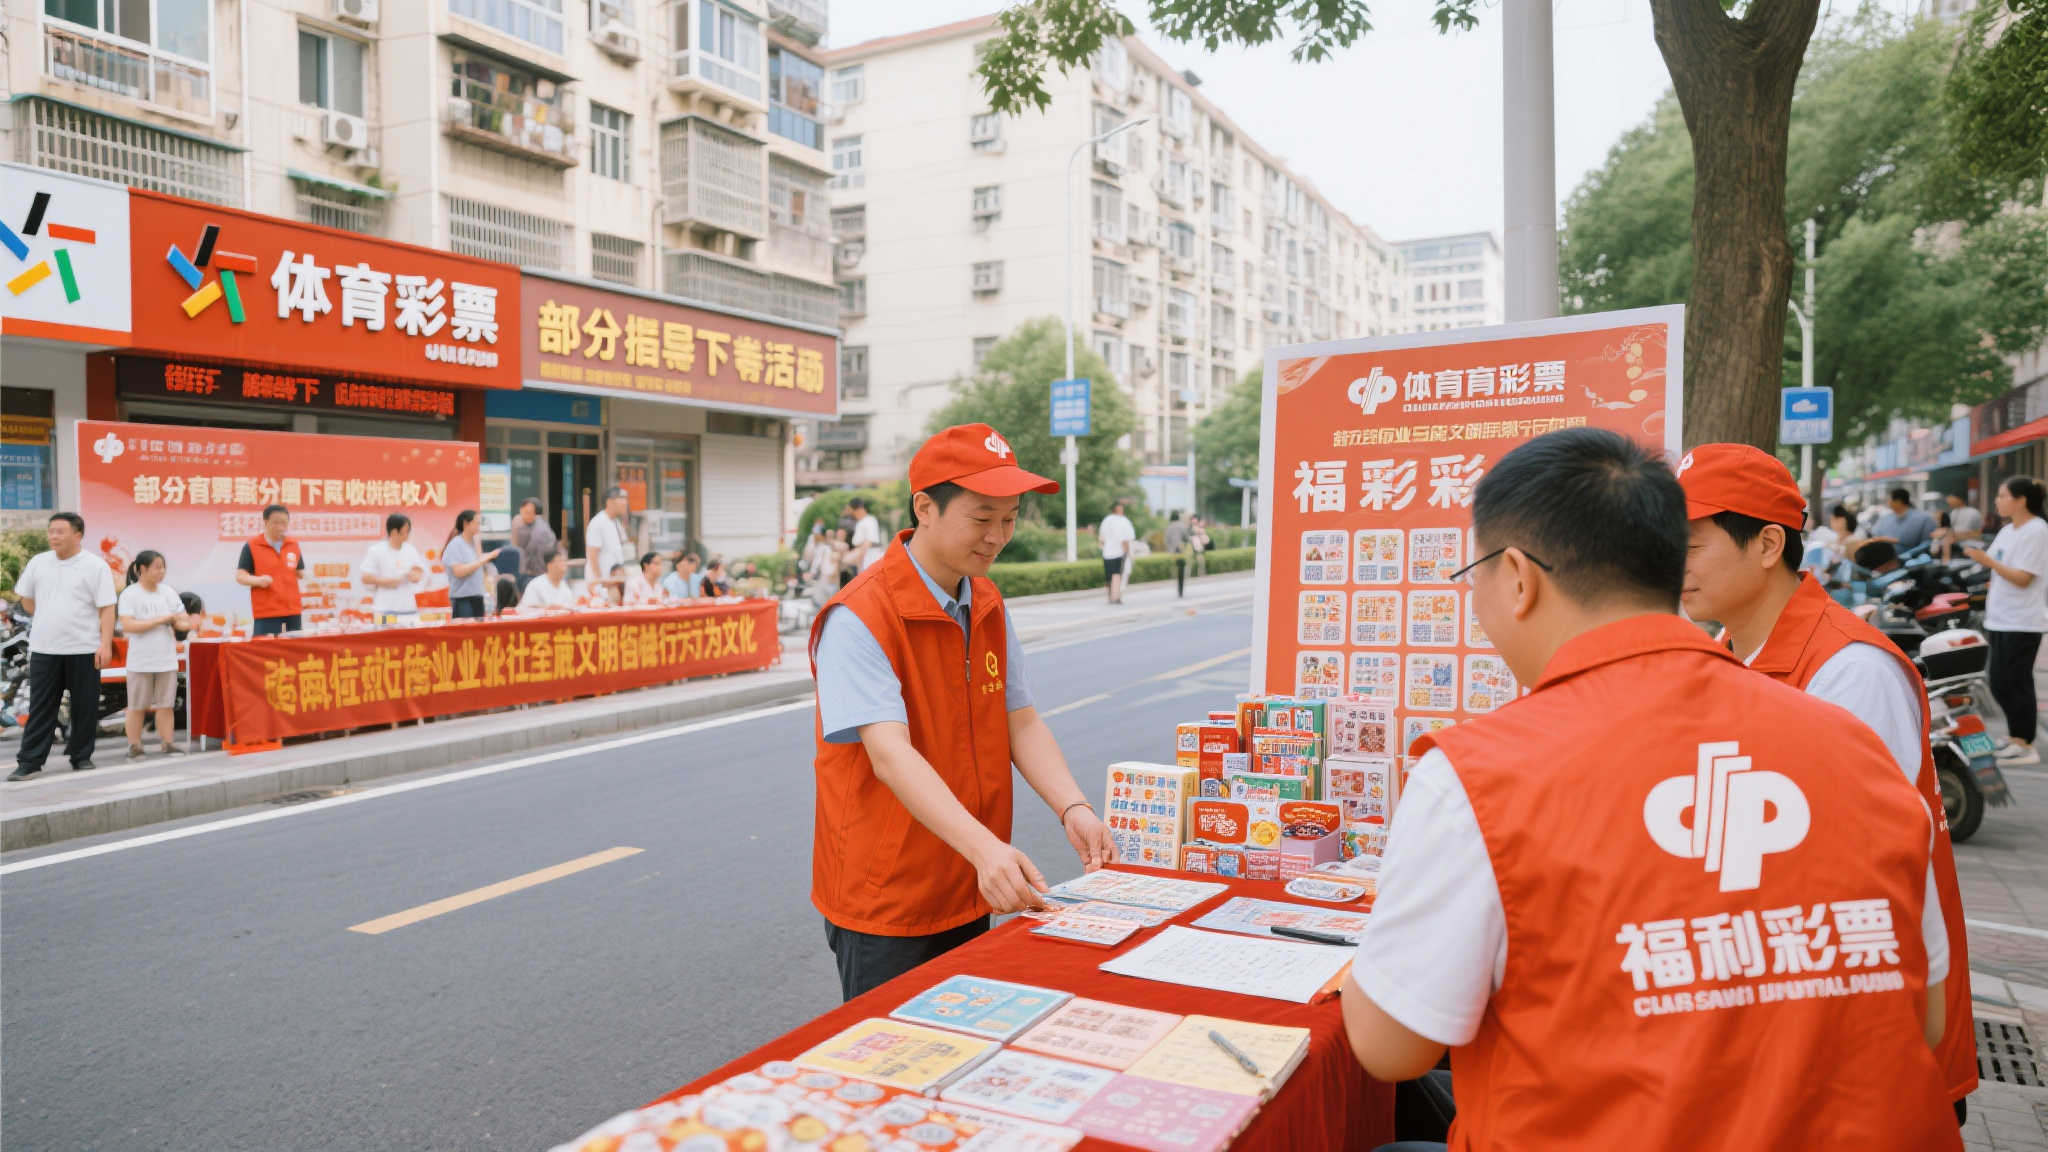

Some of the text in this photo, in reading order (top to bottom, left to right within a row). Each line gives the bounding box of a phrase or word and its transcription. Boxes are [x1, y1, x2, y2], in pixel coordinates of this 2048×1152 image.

[271, 250, 499, 344] 体育彩票
[1402, 360, 1566, 401] 体育育彩票
[1616, 898, 1901, 991] 福利彩票
